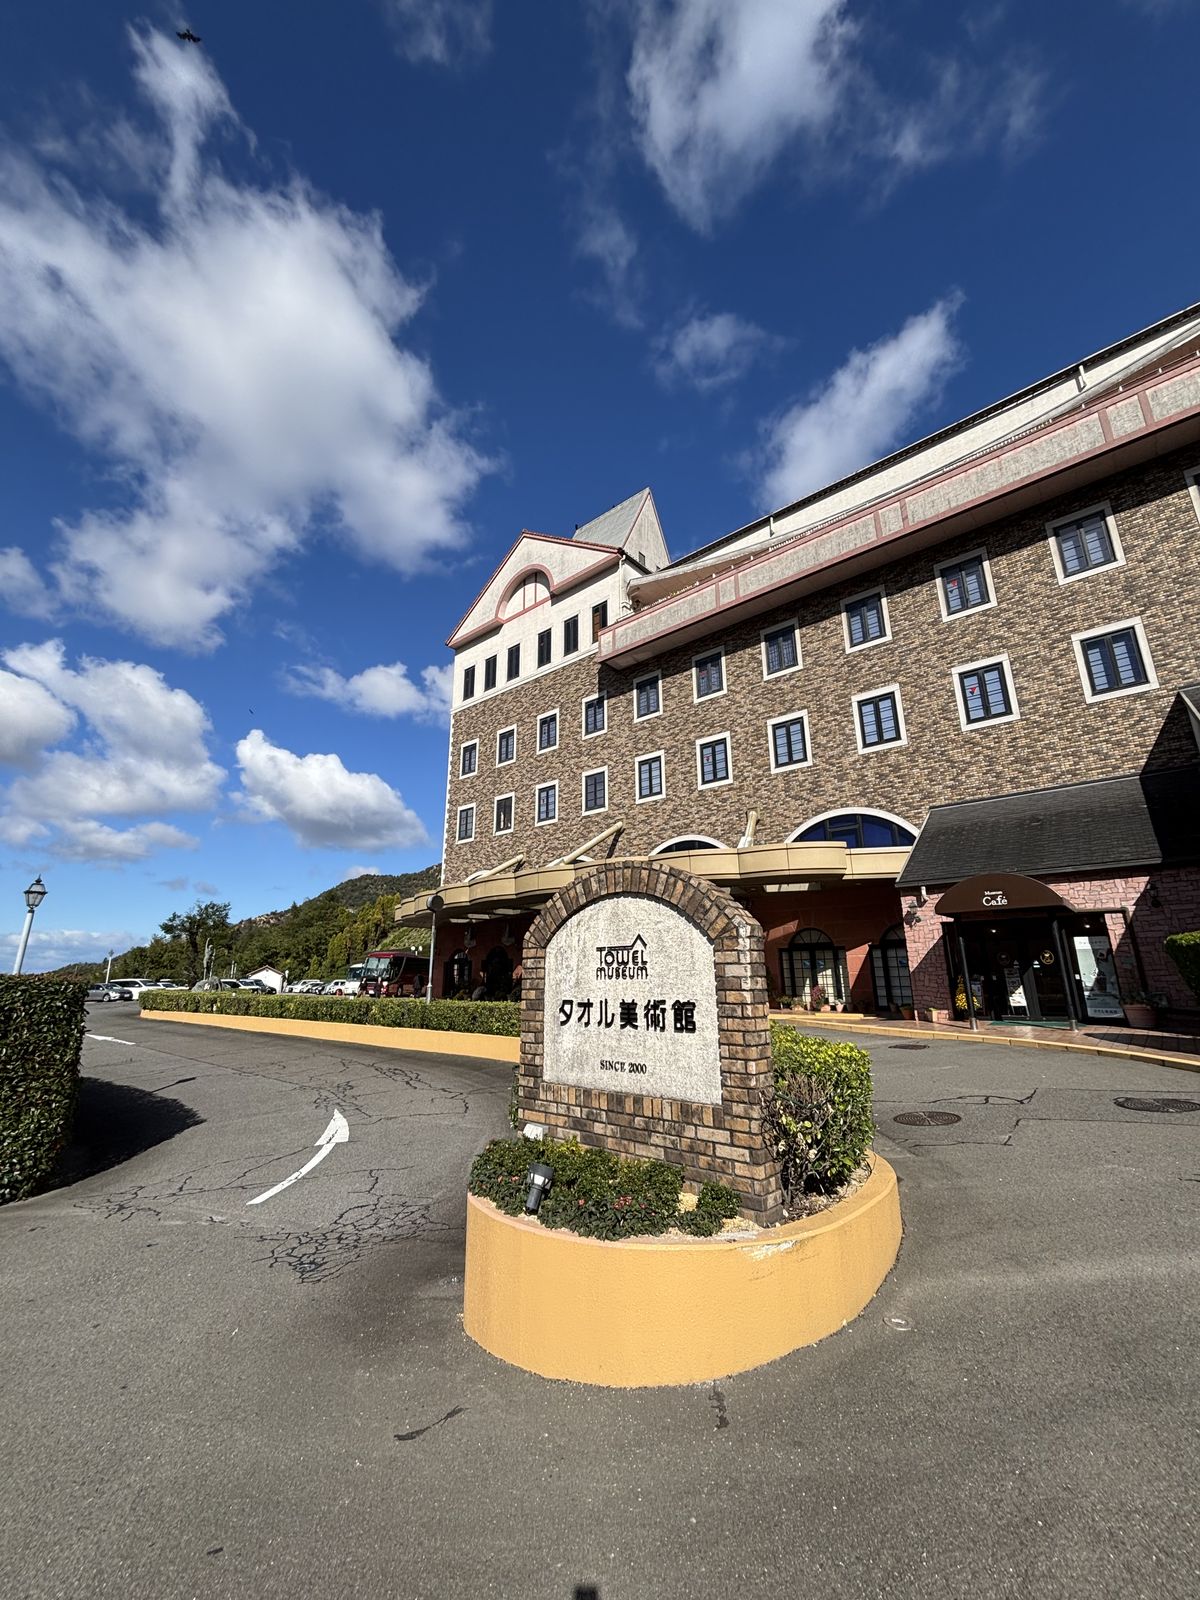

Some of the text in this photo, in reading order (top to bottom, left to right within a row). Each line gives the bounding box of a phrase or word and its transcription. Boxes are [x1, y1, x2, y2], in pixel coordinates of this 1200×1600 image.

[596, 946, 648, 966] TOWEL
[596, 966, 648, 980] MUSEUM
[559, 998, 696, 1033] タオル美術館
[600, 1060, 647, 1074] SINCE 2000
